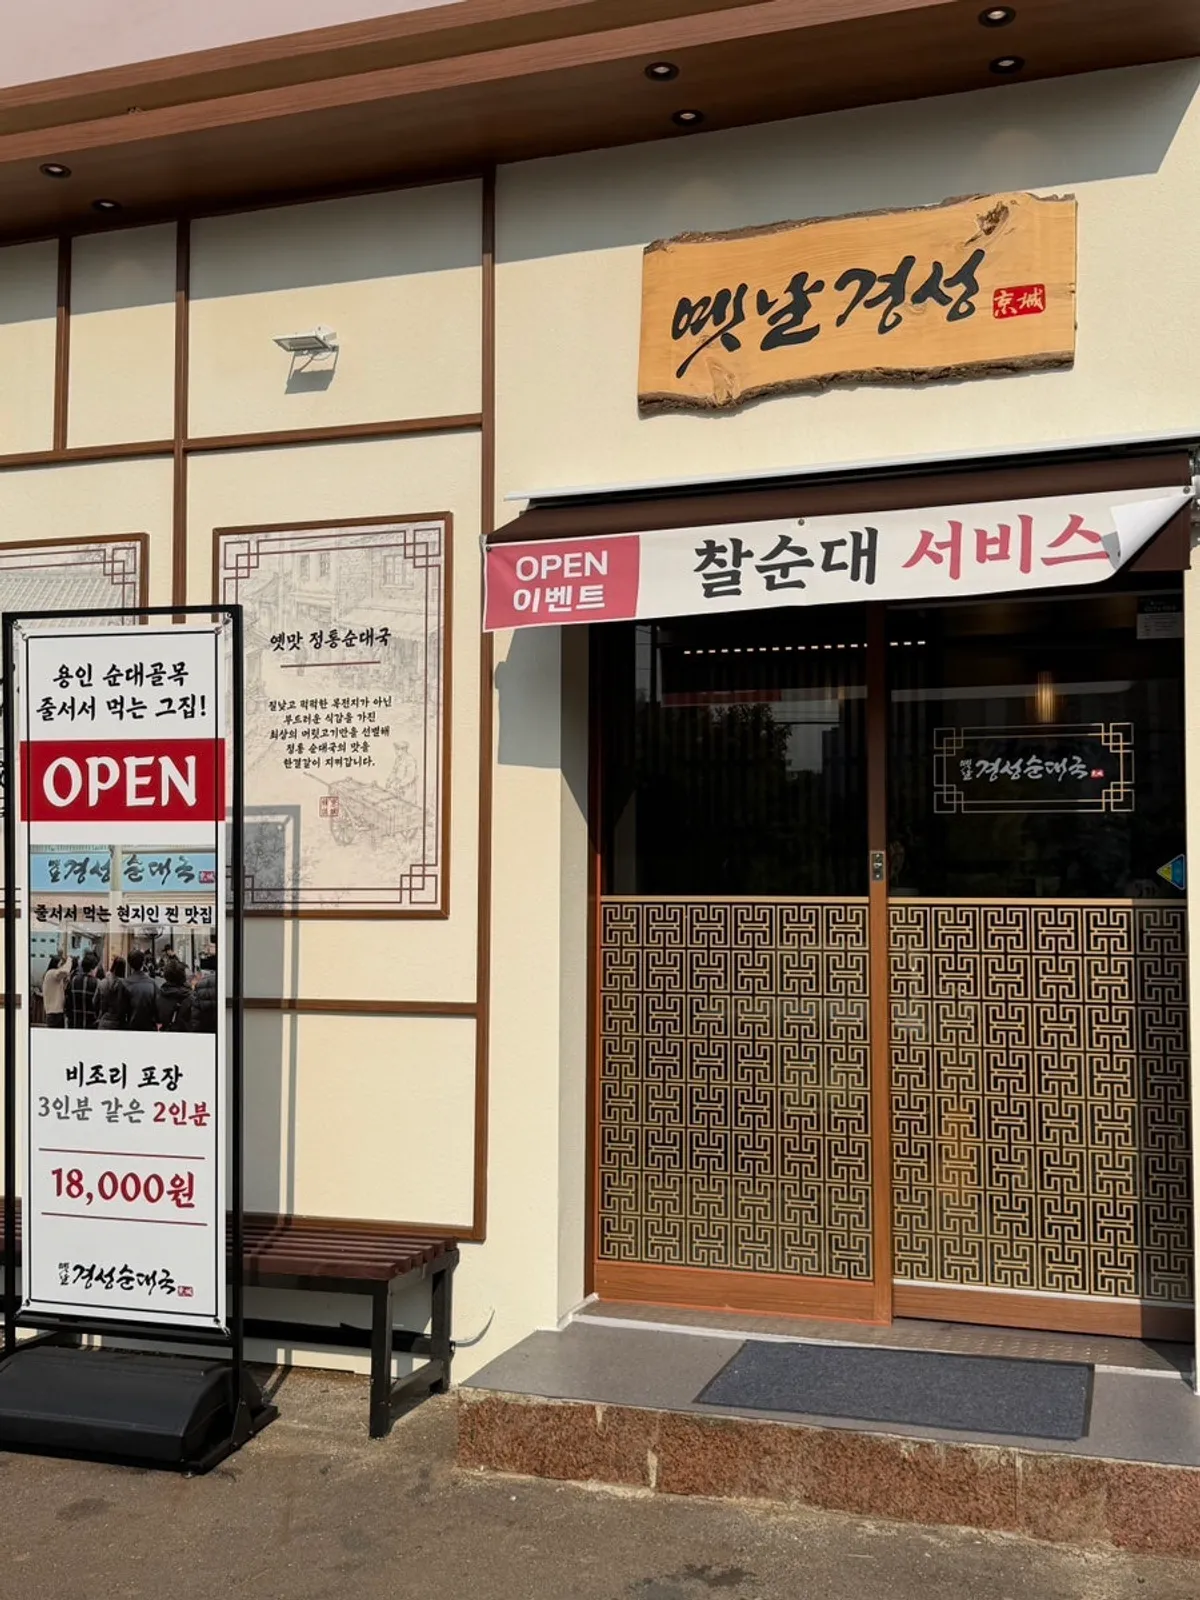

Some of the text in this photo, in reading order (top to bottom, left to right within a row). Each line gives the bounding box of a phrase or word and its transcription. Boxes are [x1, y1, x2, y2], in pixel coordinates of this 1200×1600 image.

[993, 286, 1045, 317] 京城
[515, 550, 609, 582] OPEN
[693, 514, 1111, 600] 찰순대 서비스
[513, 584, 606, 614] 이벤트
[270, 627, 392, 652] 옛맛 정통순대국
[53, 661, 190, 688] 용인 순대골목
[36, 694, 207, 721] 줄서서 먹는 그집!
[373, 695, 392, 708] 아닌
[283, 711, 377, 725] 부드러운 식감을 가진
[269, 728, 298, 740] 최상의
[362, 725, 391, 737] 선별해
[286, 741, 370, 755] 정통 순대국의 맛을
[283, 757, 321, 769] 한결같이
[975, 755, 1089, 782] 경성순대국
[43, 755, 198, 808] OPEN
[34, 904, 213, 925] 줄서서 먹는 현지인 찐 맛집
[66, 1061, 183, 1091] 비조리 포장
[38, 1095, 211, 1127] 3인분 같은 2인분
[51, 1167, 196, 1208] 18,000원
[72, 1263, 176, 1296] 경성순대국
